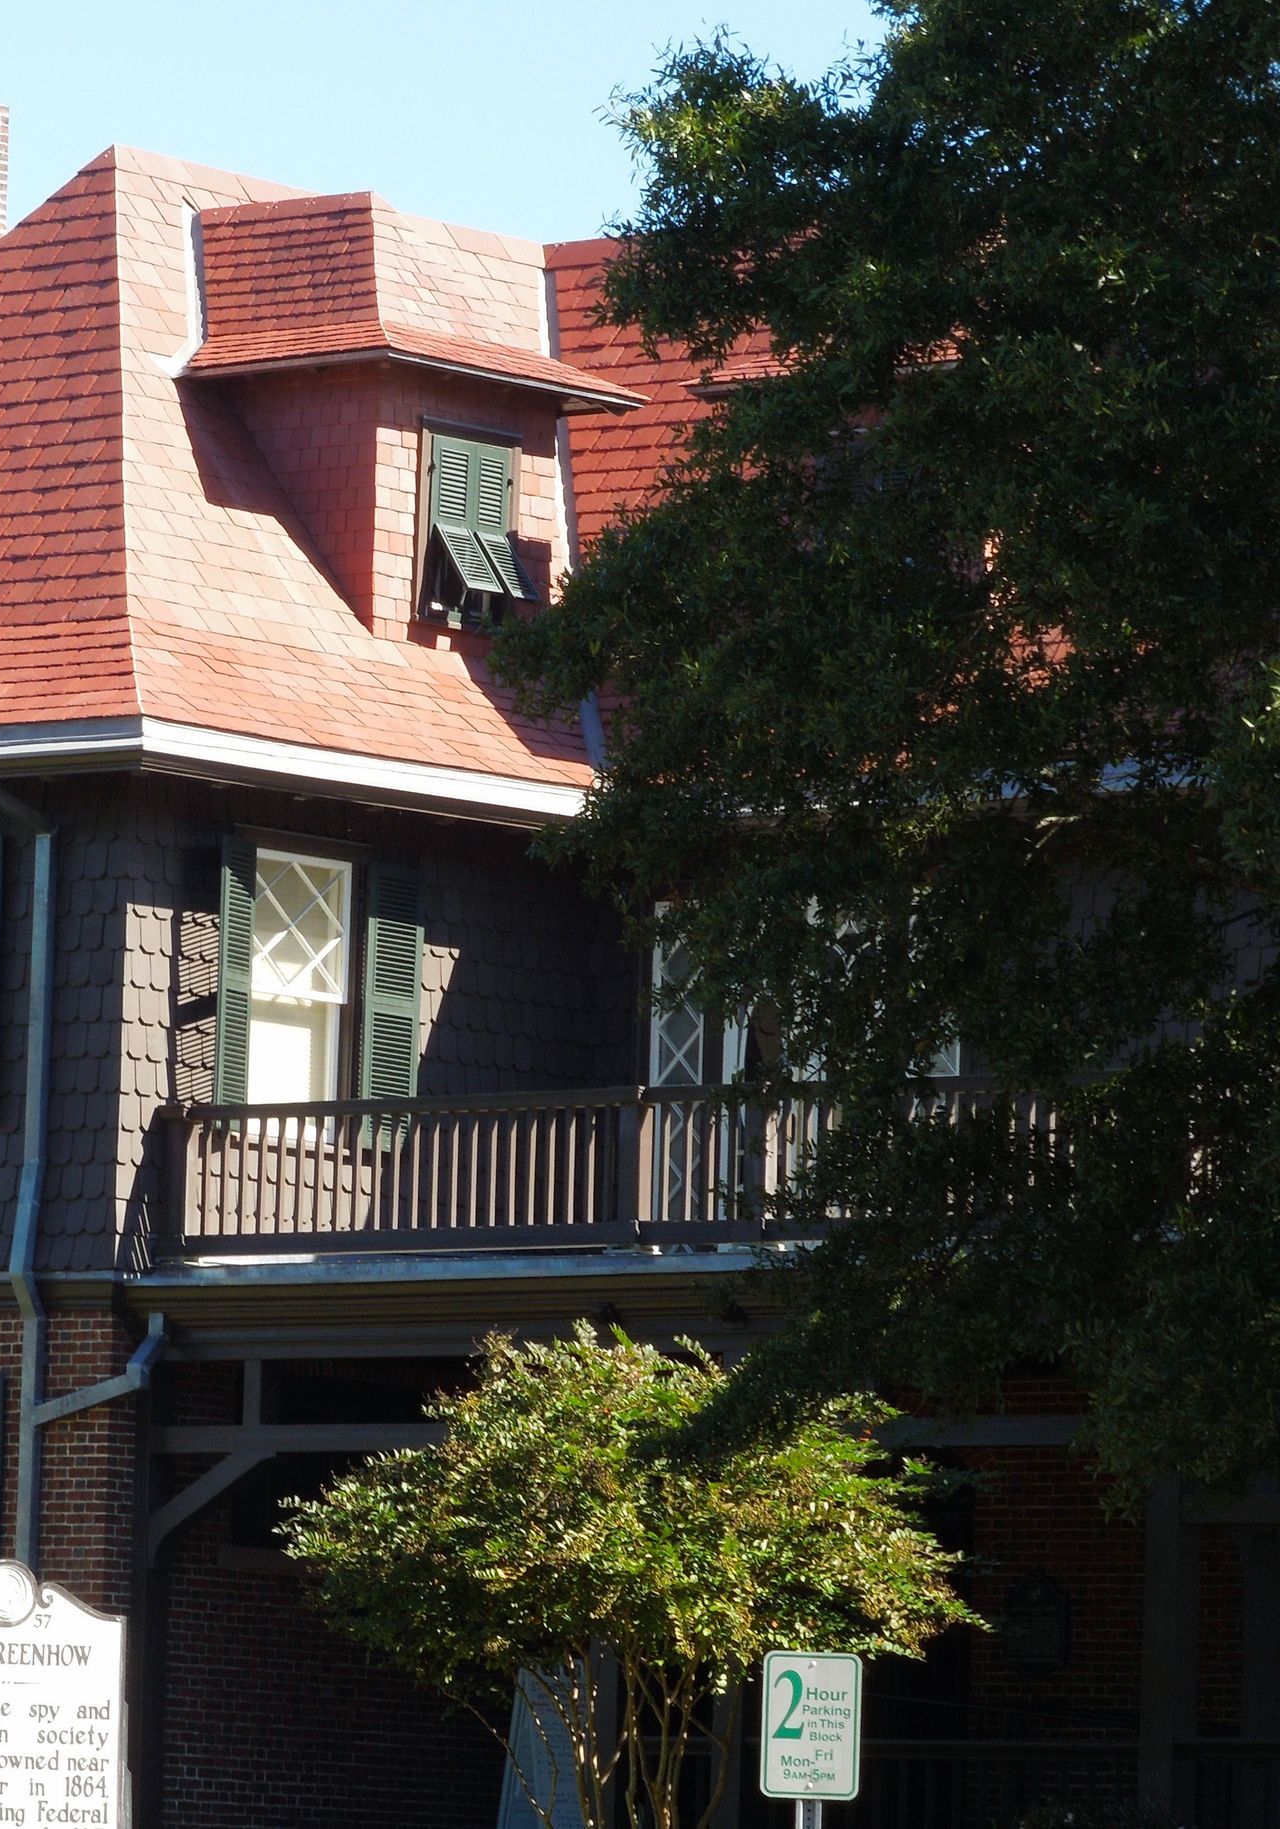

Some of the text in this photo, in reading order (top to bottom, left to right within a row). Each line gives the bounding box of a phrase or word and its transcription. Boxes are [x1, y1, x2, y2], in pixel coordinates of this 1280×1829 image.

[33, 1614, 52, 1629] 57
[806, 1687, 848, 1701] Hour
[29, 1703, 60, 1723] spy
[76, 1700, 110, 1720] and
[772, 1670, 804, 1740] 2
[802, 1704, 851, 1718] Parking
[808, 1719, 845, 1729] in This
[37, 1725, 109, 1750] society
[810, 1732, 842, 1742] Block
[68, 1755, 109, 1772] near
[29, 1778, 44, 1796] in
[38, 1800, 108, 1824] Federal
